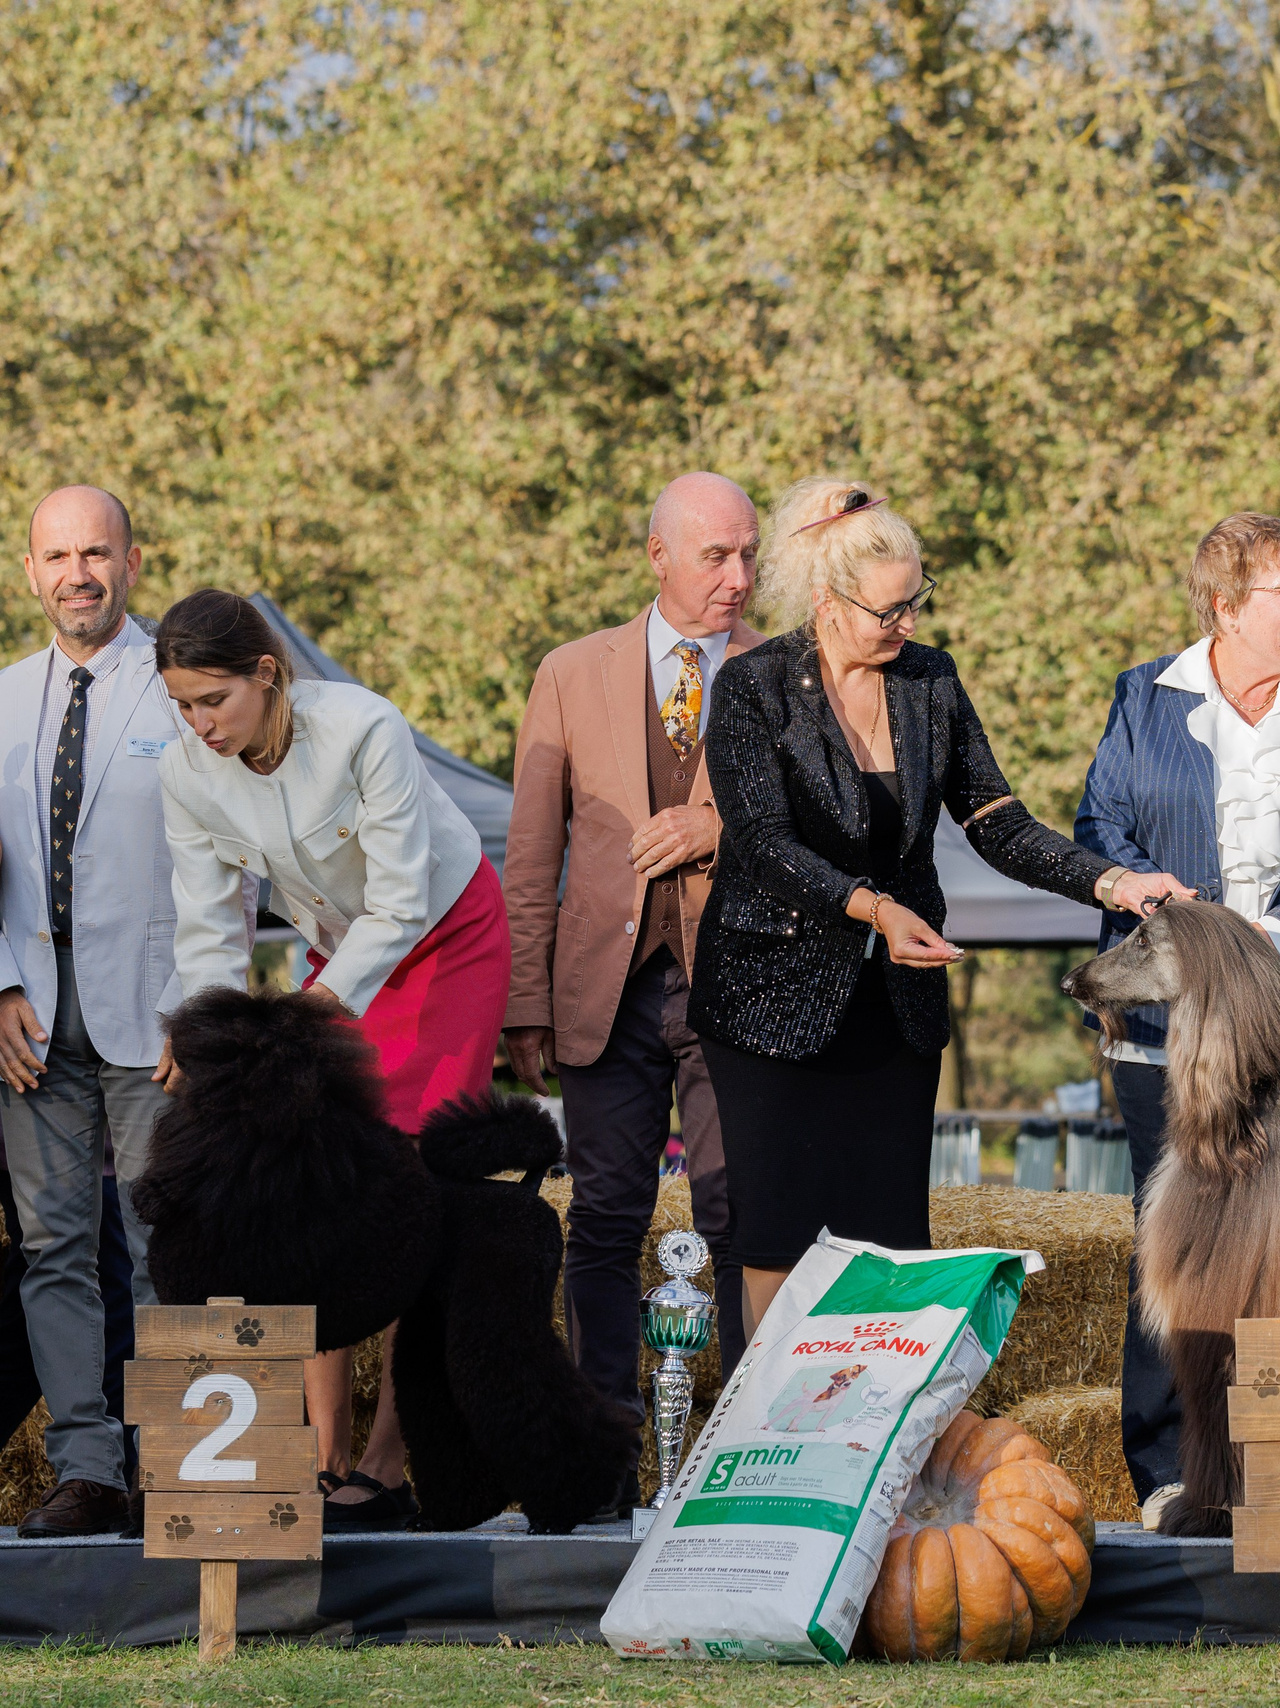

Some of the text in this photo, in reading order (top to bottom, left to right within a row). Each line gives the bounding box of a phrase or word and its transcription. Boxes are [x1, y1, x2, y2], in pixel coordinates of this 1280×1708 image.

[792, 1337, 932, 1357] ROYAL CANIN
[178, 1373, 258, 1481] 2
[742, 1445, 804, 1466] mini
[710, 1459, 734, 1485] S
[734, 1472, 778, 1487] adult
[709, 1645, 720, 1656] S
[722, 1639, 744, 1650] mini
